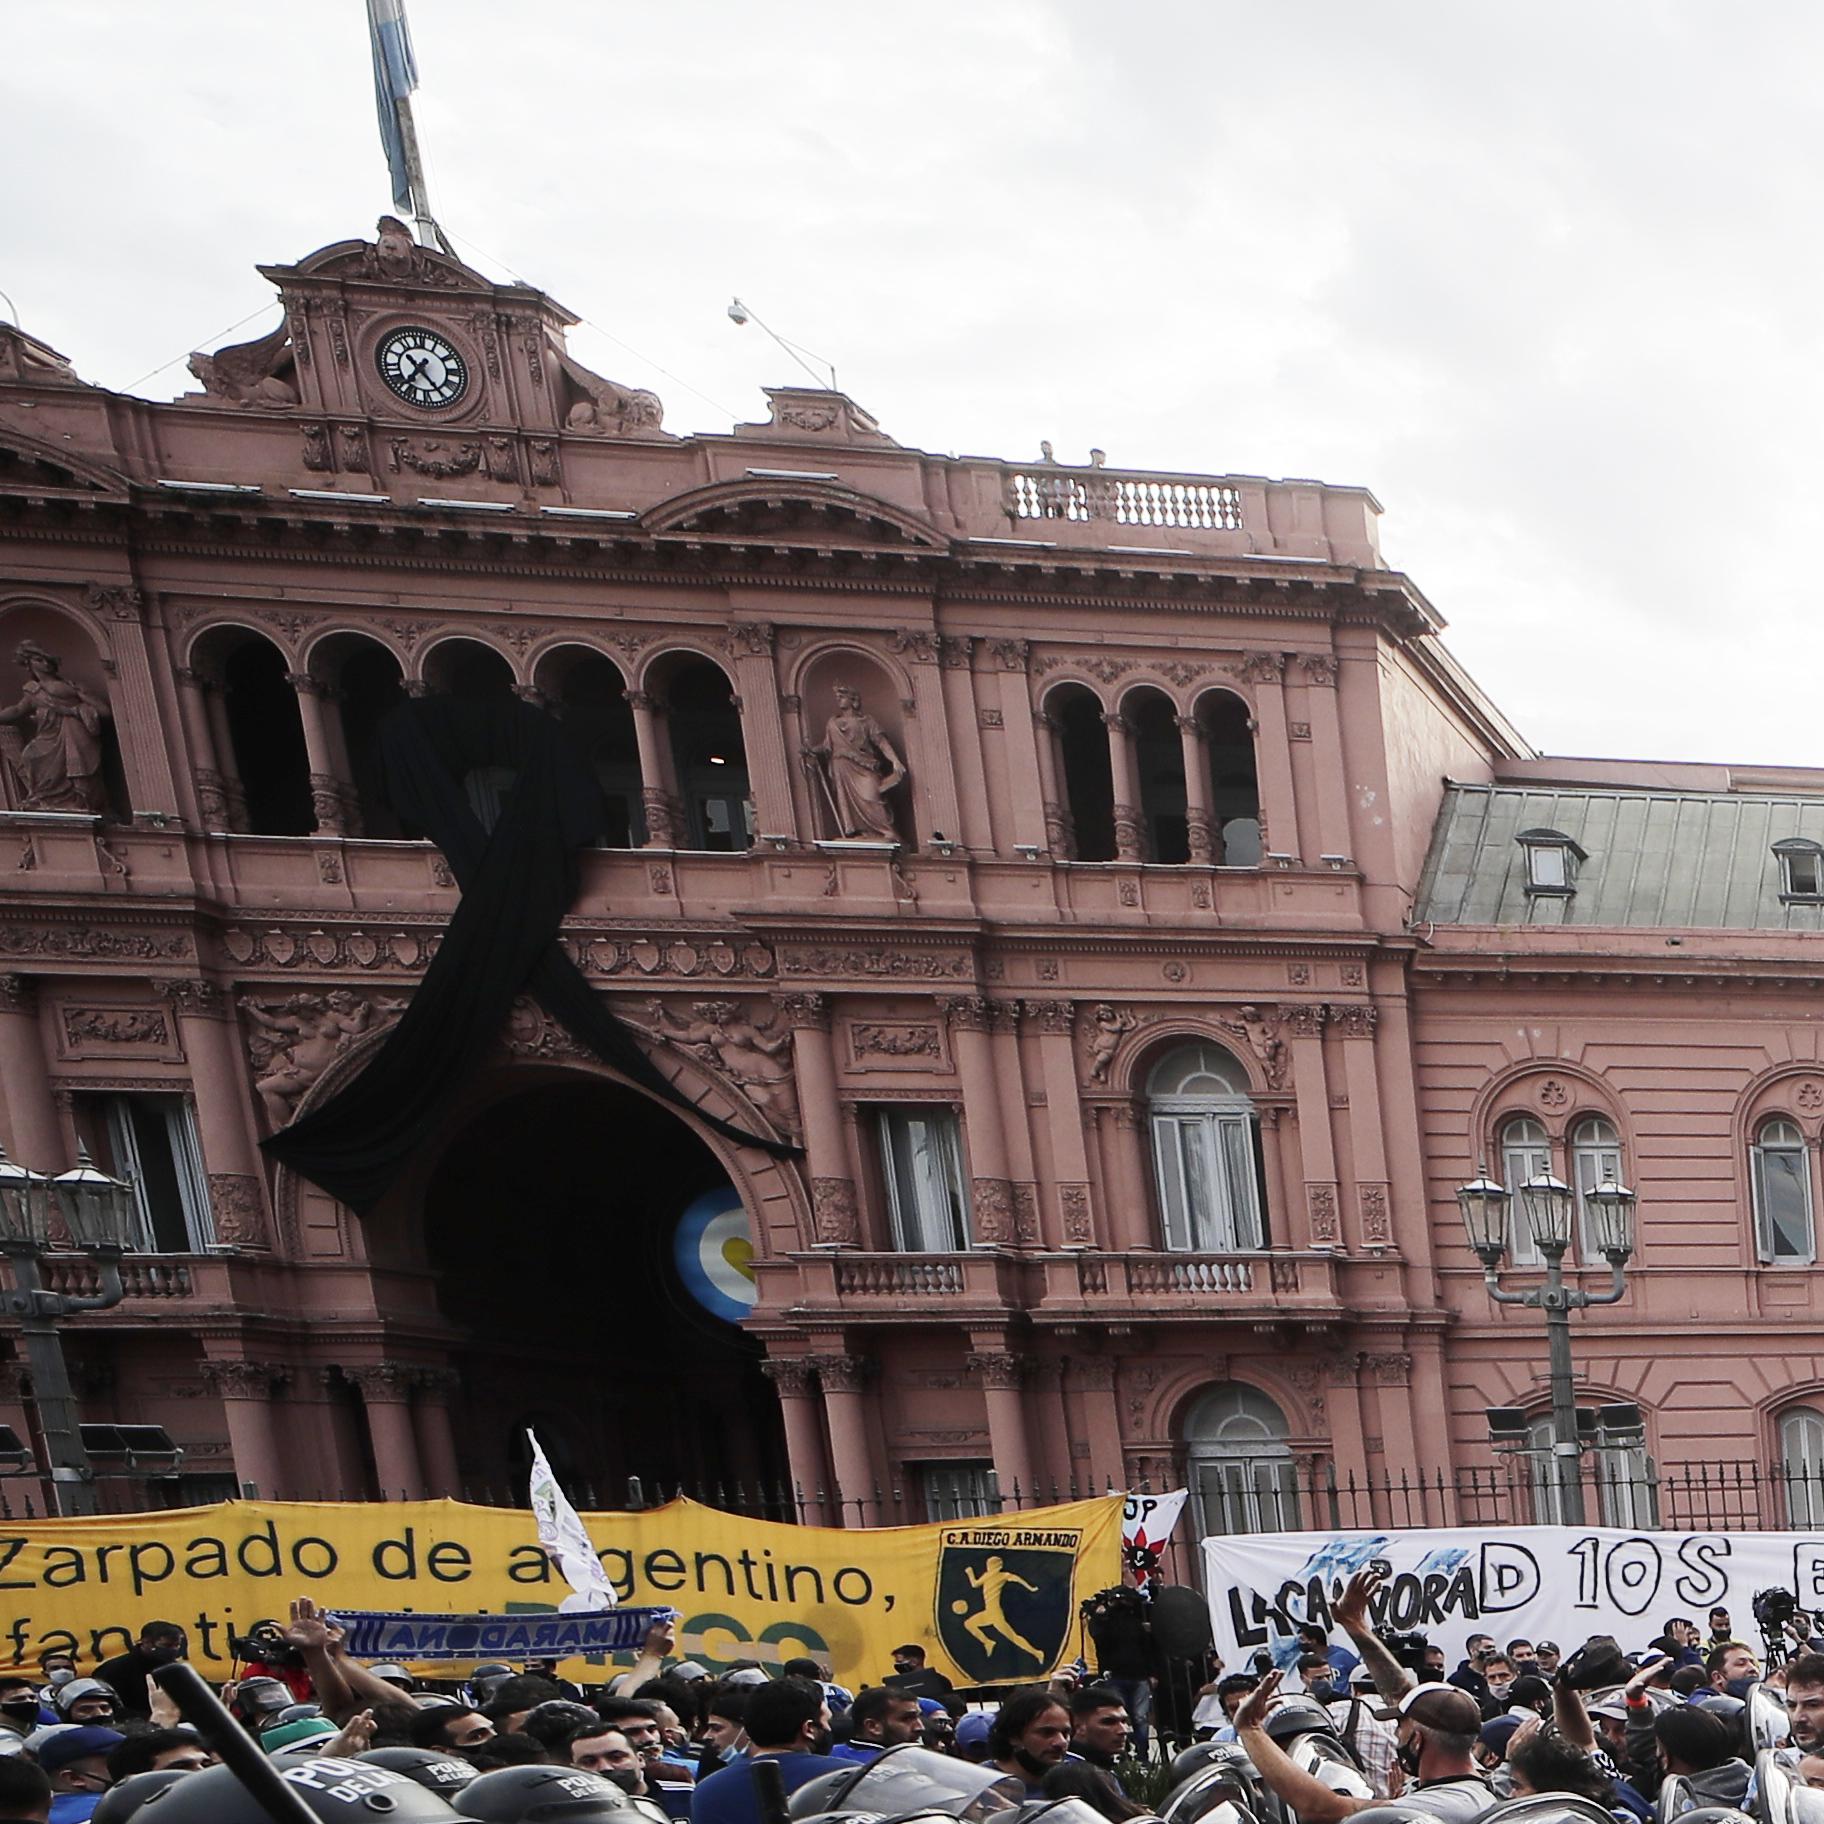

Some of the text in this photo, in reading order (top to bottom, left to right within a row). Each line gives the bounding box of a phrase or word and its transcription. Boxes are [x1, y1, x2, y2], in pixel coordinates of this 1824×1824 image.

[0, 1519, 896, 1613] Zarpado de agentino,
[1012, 1532, 1078, 1549] ARMANDO
